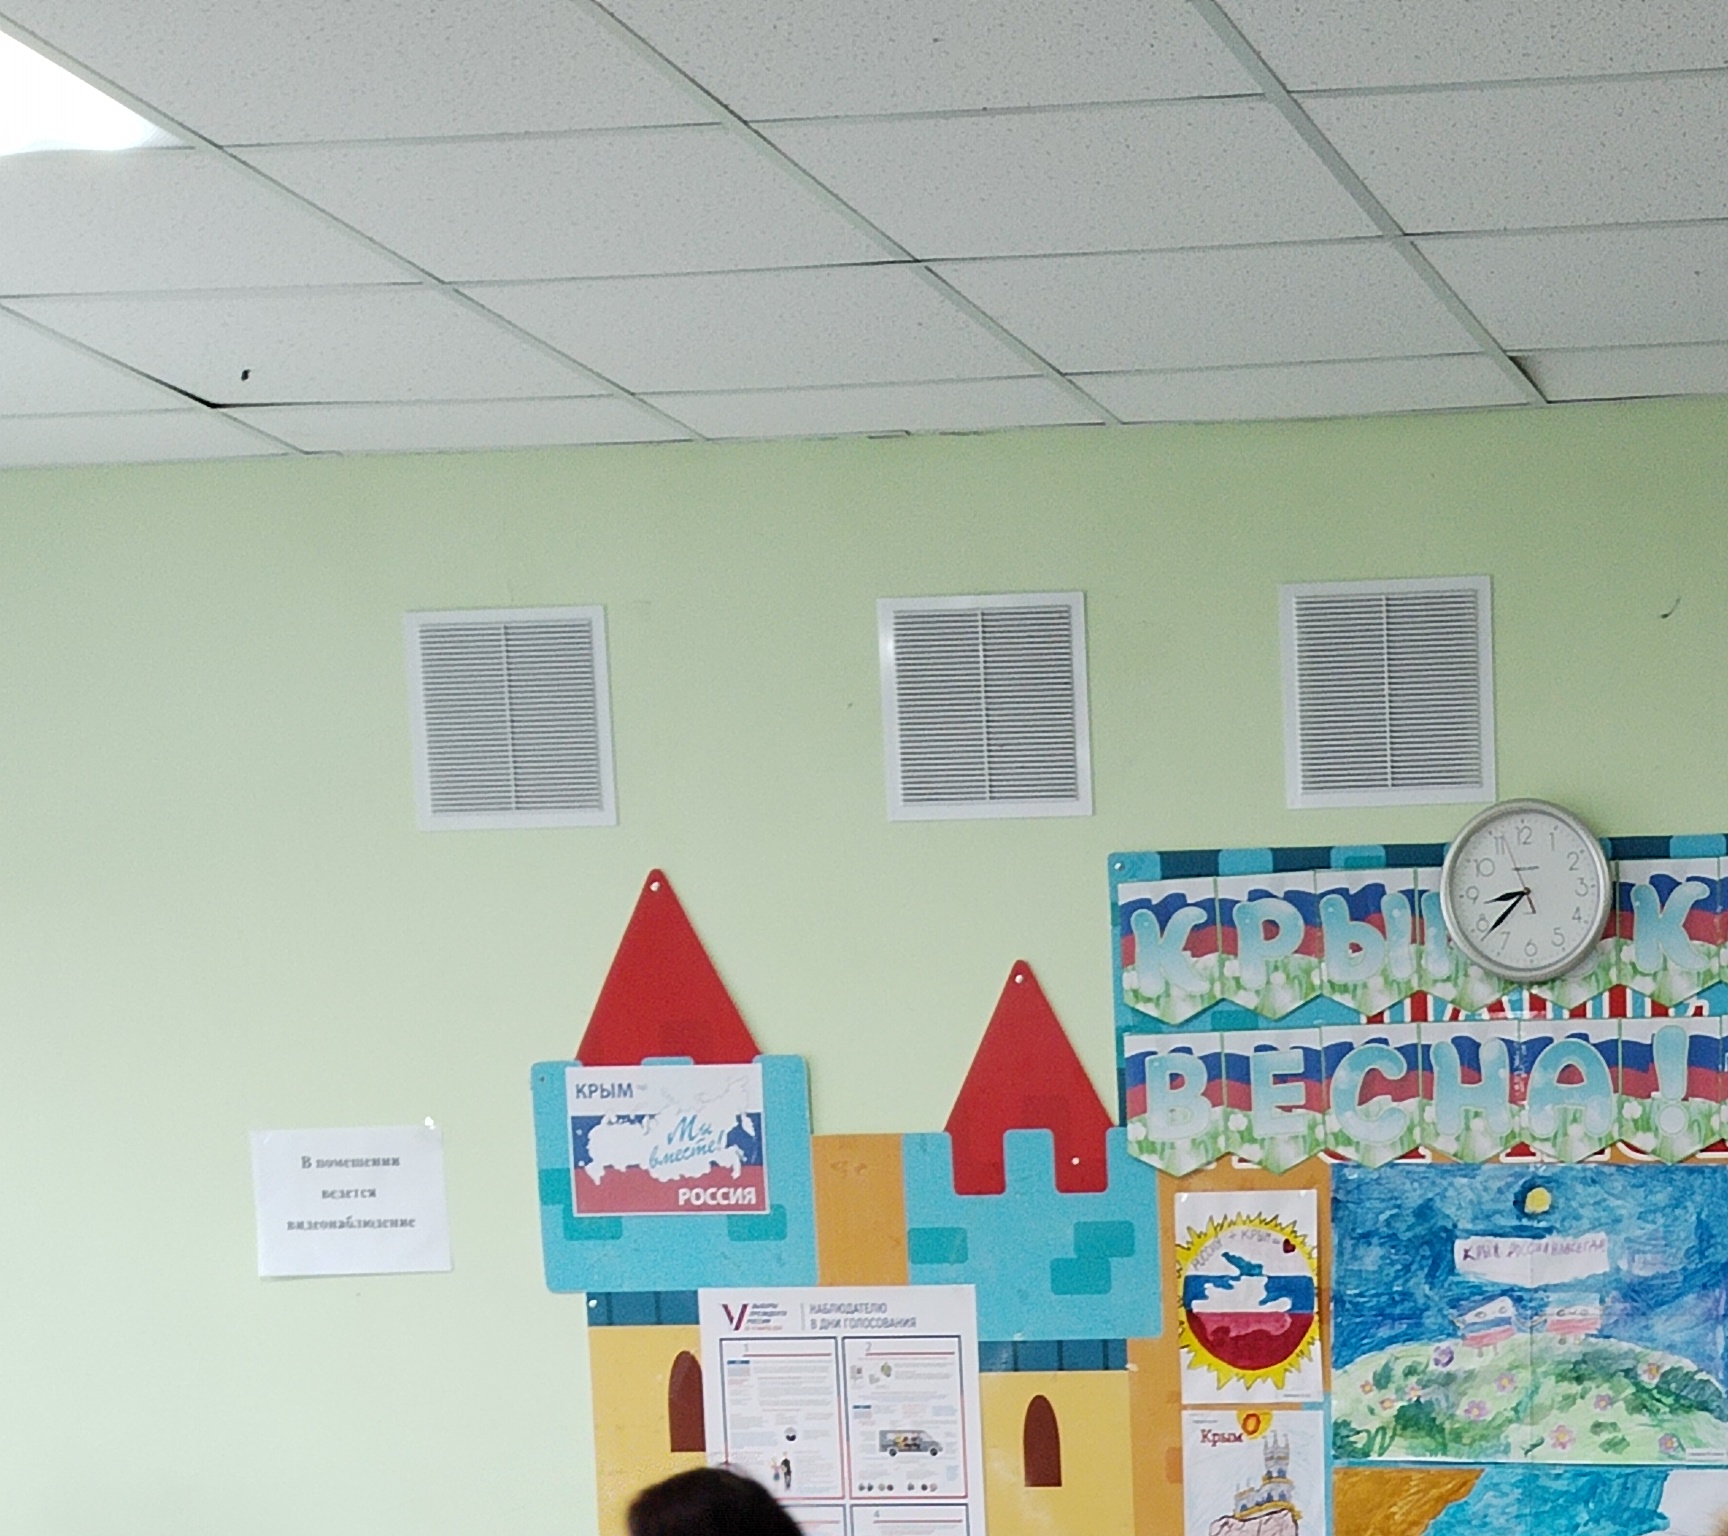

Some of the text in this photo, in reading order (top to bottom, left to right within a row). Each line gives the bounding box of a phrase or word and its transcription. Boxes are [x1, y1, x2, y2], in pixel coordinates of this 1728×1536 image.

[1493, 834, 1506, 855] 11
[1514, 825, 1532, 845] 12
[1548, 832, 1556, 850] 1
[1474, 857, 1496, 877] 10
[1566, 851, 1579, 871] 2
[1465, 885, 1480, 904] 9
[1575, 877, 1589, 897] 3
[1476, 913, 1490, 933] 8
[1571, 906, 1582, 923] 4
[1501, 930, 1511, 950] 7
[1551, 926, 1565, 947] 5
[1523, 938, 1538, 957] 6
[575, 1083, 634, 1099] КРЫМ
[1144, 1024, 1690, 1146] ВЕСНА!
[648, 1129, 725, 1169] вместе!
[300, 1155, 312, 1169] В
[678, 1187, 757, 1206] РОССИЯ
[808, 1302, 888, 1315] НАБЛЮДАТЕЛЮ
[843, 1316, 917, 1330] ГОЛОСОВАНИЯ
[1200, 1428, 1245, 1447] Крым
